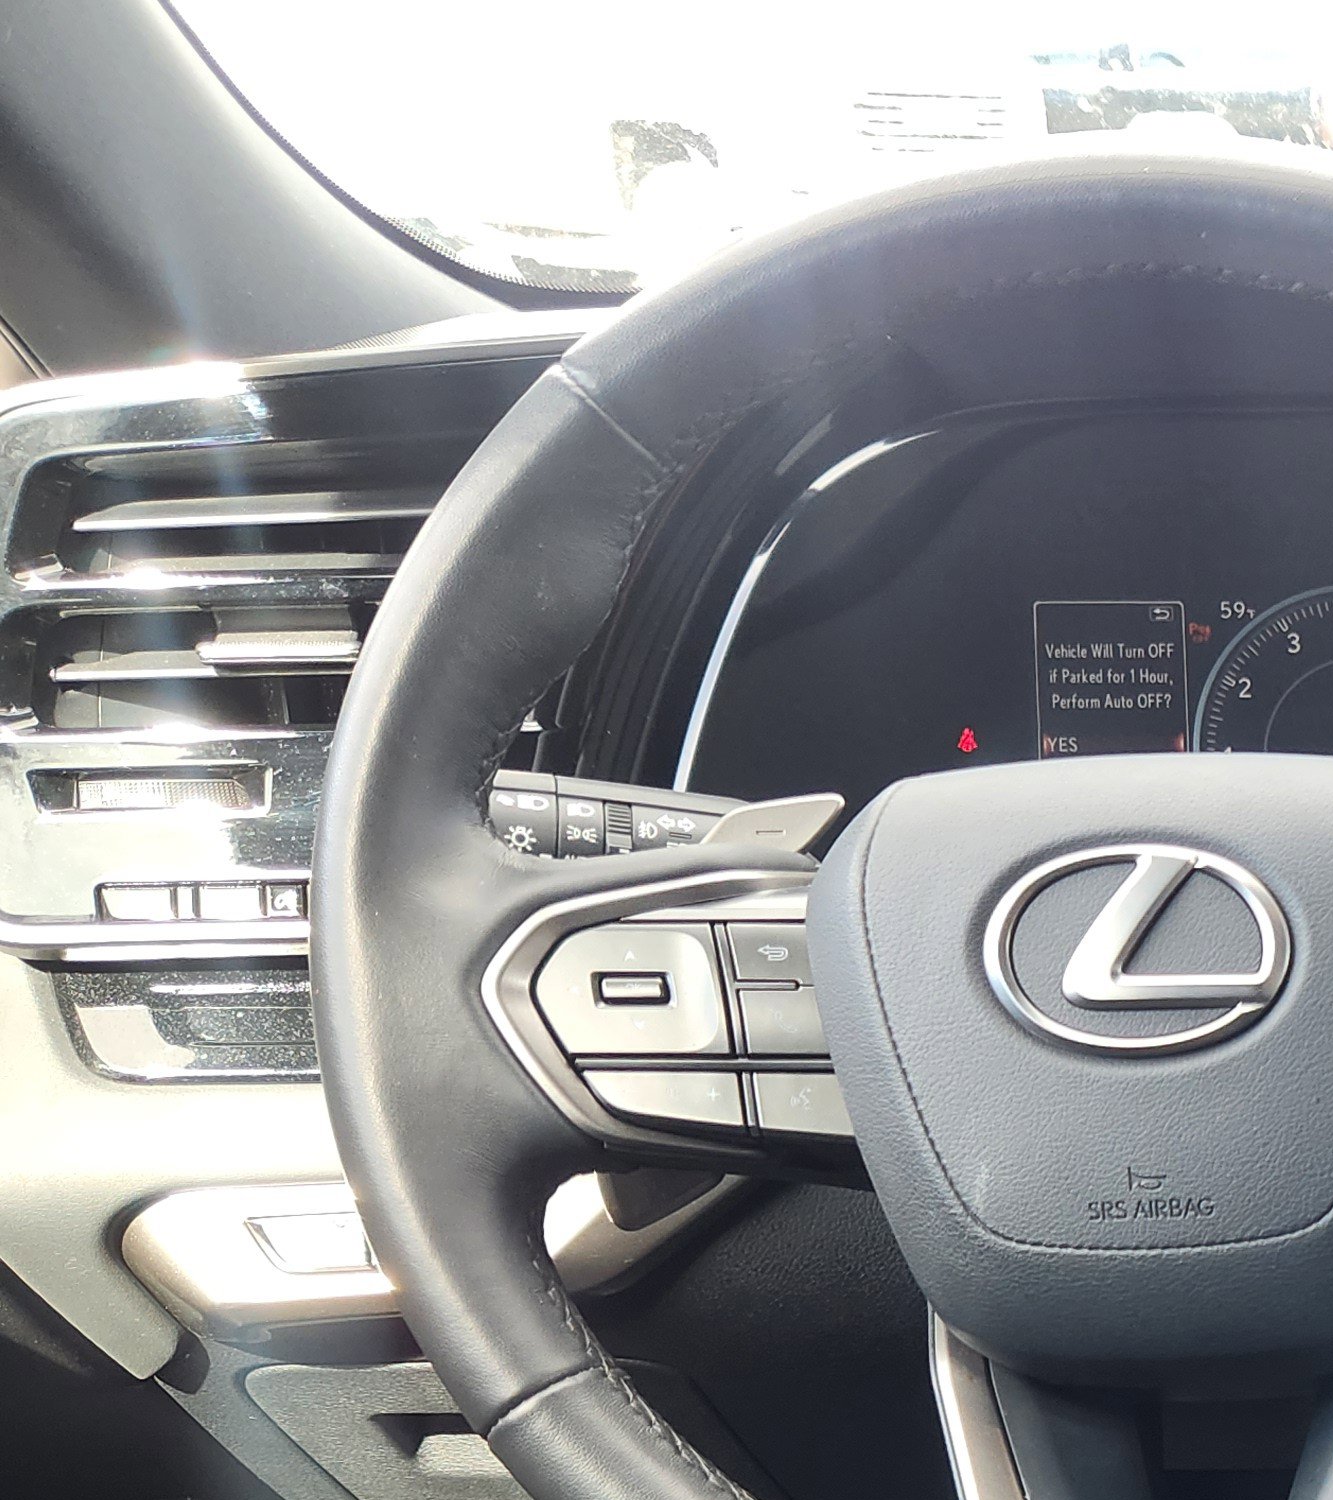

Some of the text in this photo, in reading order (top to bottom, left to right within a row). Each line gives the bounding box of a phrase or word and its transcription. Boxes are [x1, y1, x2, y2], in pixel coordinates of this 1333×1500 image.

[1045, 643, 1175, 660] Vehicle Will Turn OFF
[1286, 632, 1302, 654] 3
[1049, 669, 1175, 687] if Parked for 1 Hour,
[1238, 677, 1252, 699] 2
[1051, 693, 1172, 711] Perform Auto OFF?
[1047, 737, 1078, 753] YES
[1087, 1197, 1215, 1221] SRS AIRBAG
